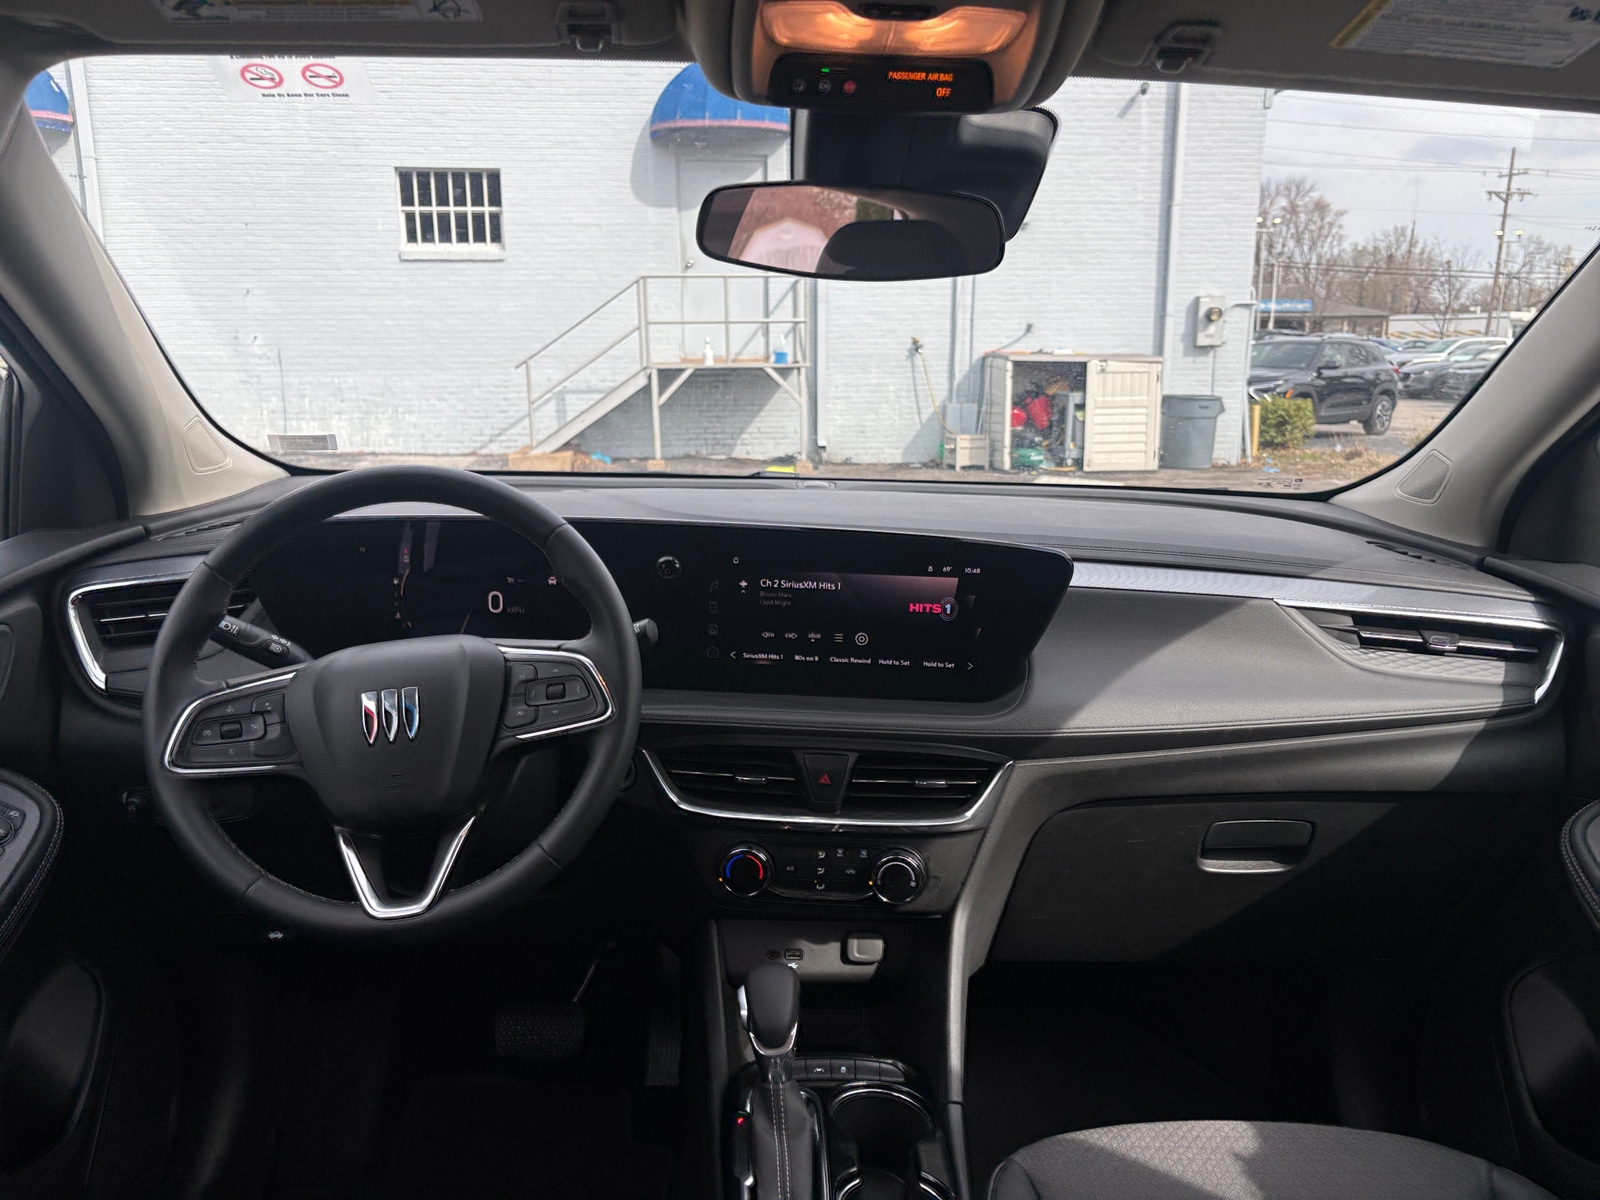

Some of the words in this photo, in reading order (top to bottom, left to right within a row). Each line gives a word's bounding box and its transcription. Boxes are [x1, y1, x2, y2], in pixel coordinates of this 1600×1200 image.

[888, 72, 926, 80] PASSENGER
[927, 73, 938, 81] AIR
[939, 73, 953, 82] BAG
[936, 88, 951, 97] OFF
[760, 578, 772, 588] Ch
[773, 579, 779, 588] 2
[780, 579, 817, 590] SiriusXM
[818, 581, 836, 590] Hits
[487, 590, 505, 615] 0
[775, 600, 792, 608] Might
[506, 607, 526, 615] MPH
[909, 602, 942, 614] HITS
[944, 603, 952, 615] 1
[742, 652, 768, 660] SiriusXM
[830, 656, 849, 664] Classic
[850, 657, 871, 665] Rewind
